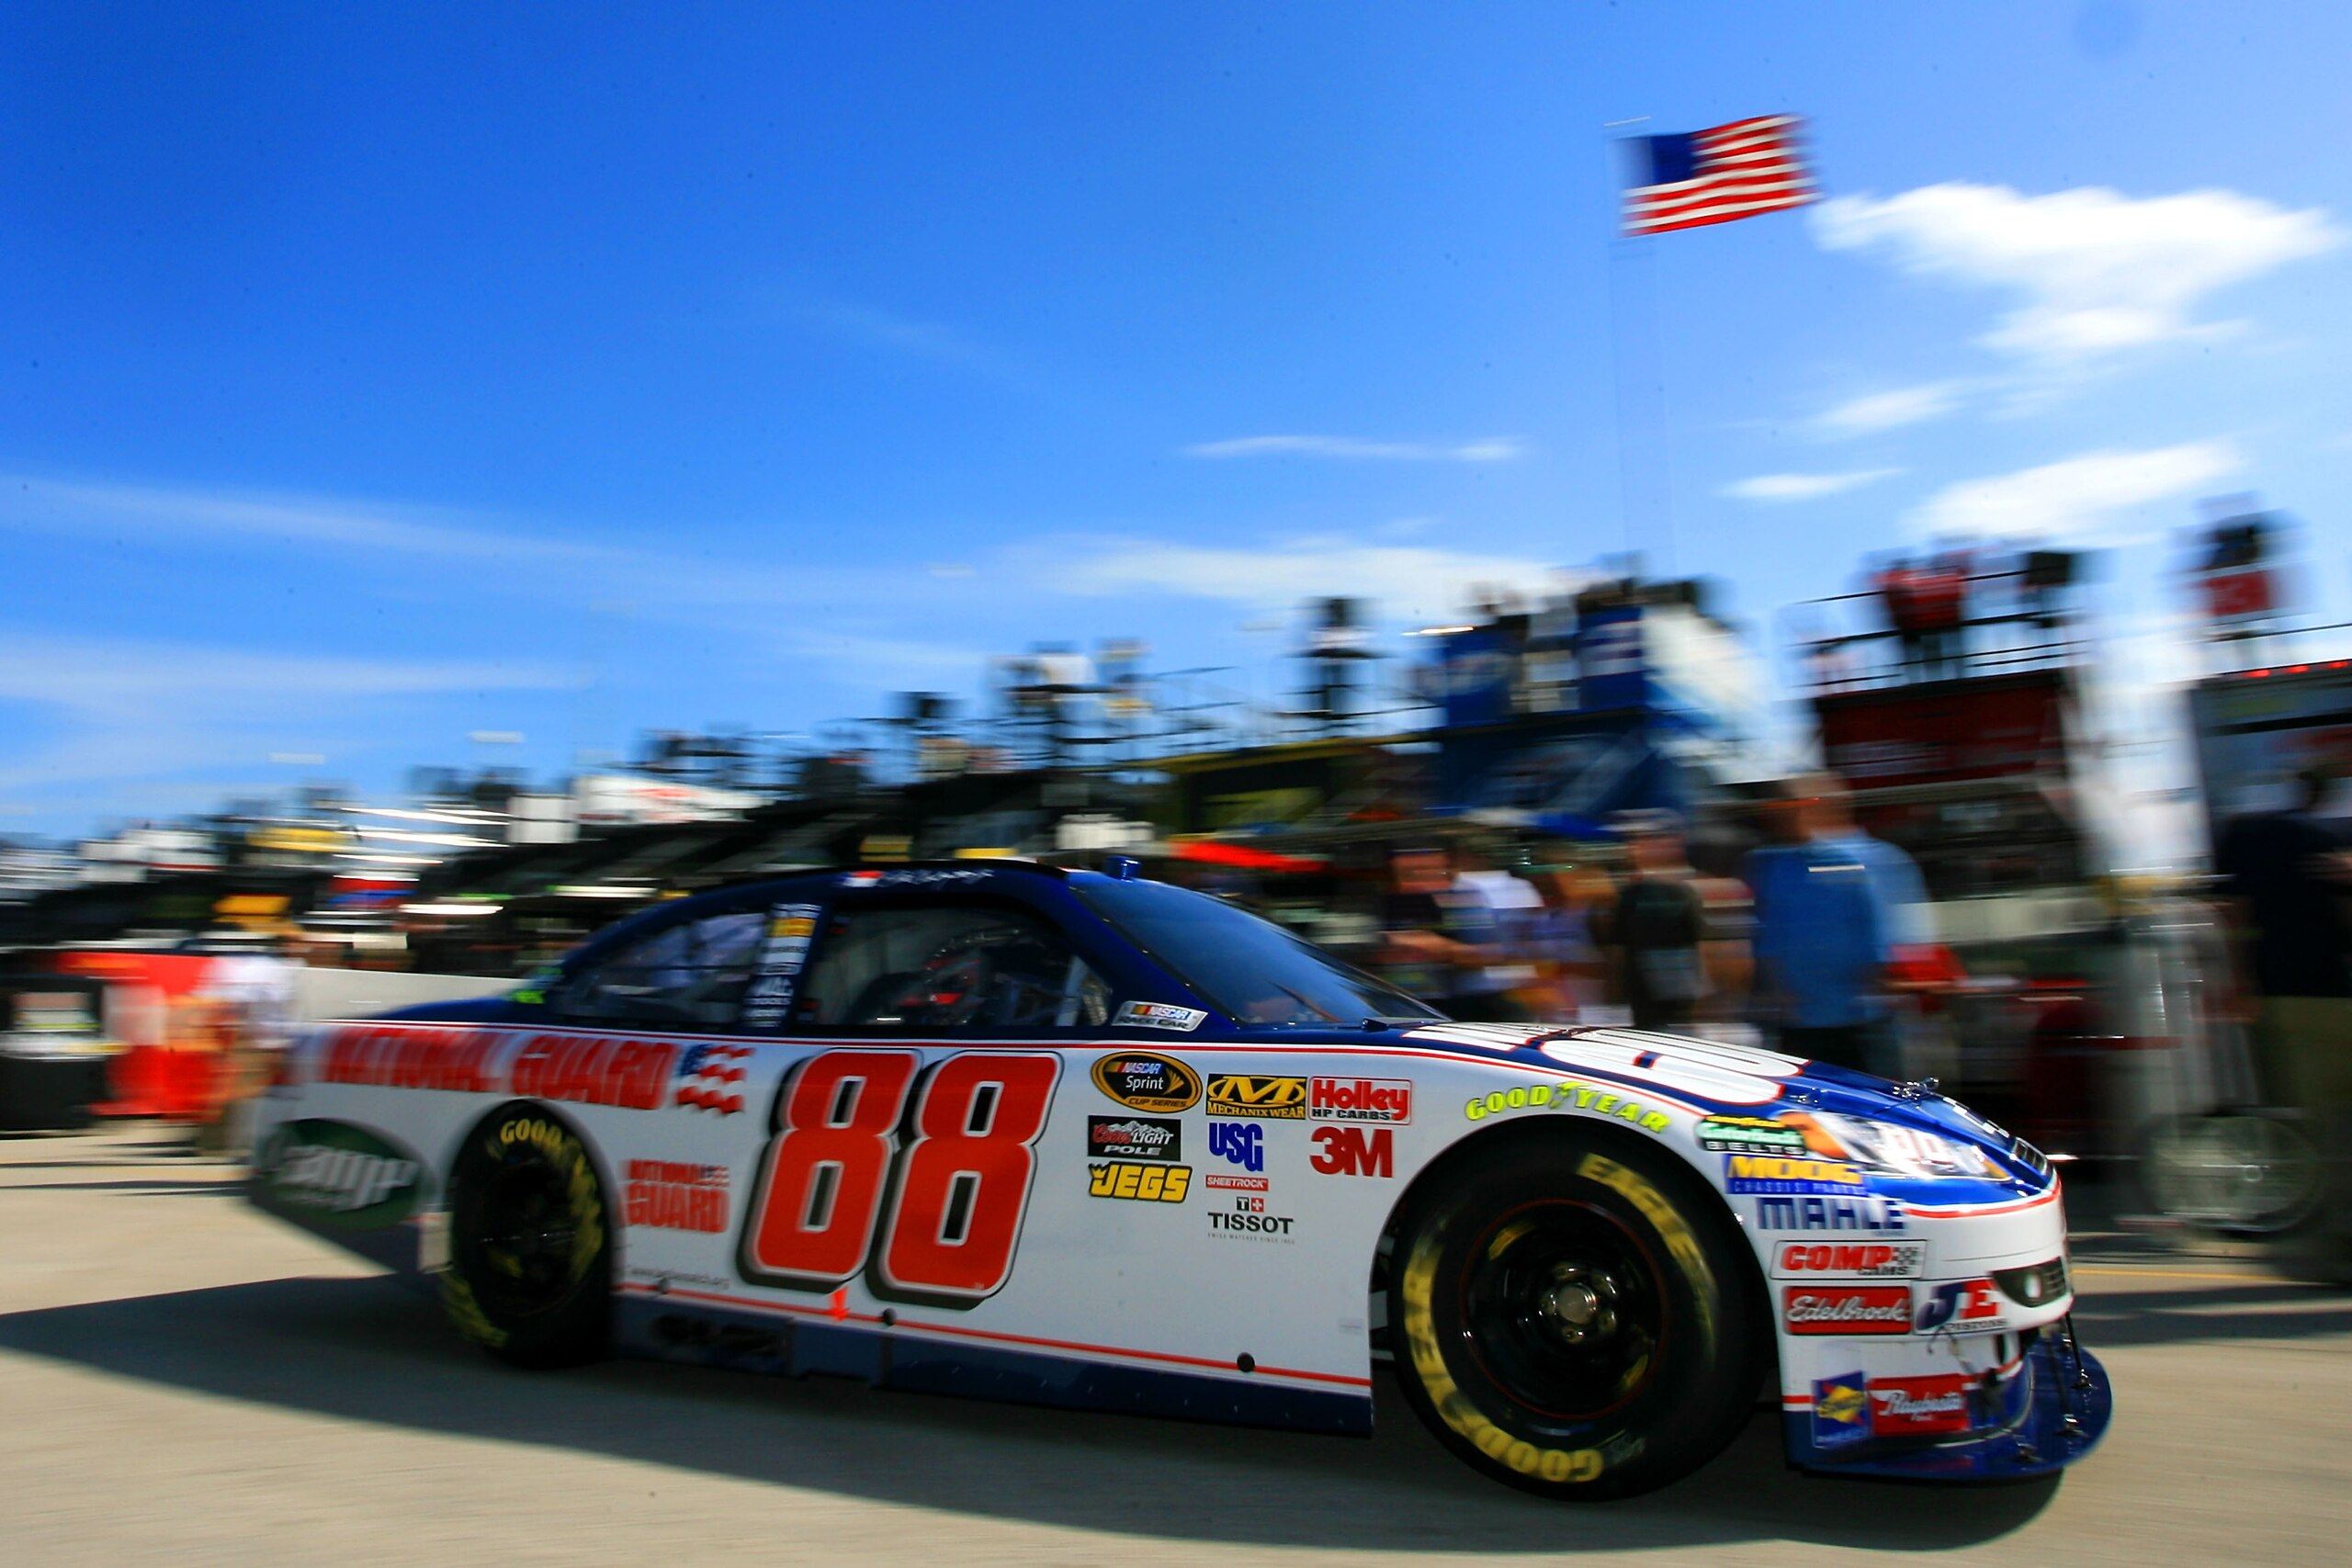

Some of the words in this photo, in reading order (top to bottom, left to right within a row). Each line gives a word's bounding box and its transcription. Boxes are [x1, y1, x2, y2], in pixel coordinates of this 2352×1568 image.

[1148, 1006, 1192, 1021] NASCAR
[1157, 1019, 1189, 1029] CAR
[511, 1034, 678, 1111] GUARD
[1125, 1062, 1161, 1074] NASCAR
[1125, 1076, 1164, 1091] Sprint
[1128, 1097, 1150, 1105] CUP
[1152, 1099, 1187, 1107] SERIES
[1312, 1079, 1408, 1121] Holley
[1207, 1101, 1268, 1117] MECHANIX
[1269, 1105, 1305, 1118] WEAR
[1312, 1109, 1332, 1117] HP
[1337, 1110, 1390, 1120] CARBS
[1131, 1128, 1174, 1145] LIGHT
[1103, 1145, 1162, 1156] POLE
[1209, 1122, 1263, 1172] USG
[1310, 1126, 1393, 1178] 3M
[1705, 1141, 1804, 1155] BELTS
[741, 1047, 1062, 1306] 88
[1728, 1156, 1864, 1185] MOOG
[1090, 1162, 1193, 1202] JEGS
[1206, 1177, 1264, 1189] SHEETROCK
[1735, 1181, 1804, 1193] CHASSIS
[627, 1182, 730, 1232] GUARD
[1207, 1212, 1294, 1234] TISSOT
[1781, 1246, 1894, 1270] COMP
[1857, 1266, 1908, 1276] CAMS
[1787, 1295, 1912, 1323] Edelbrock
